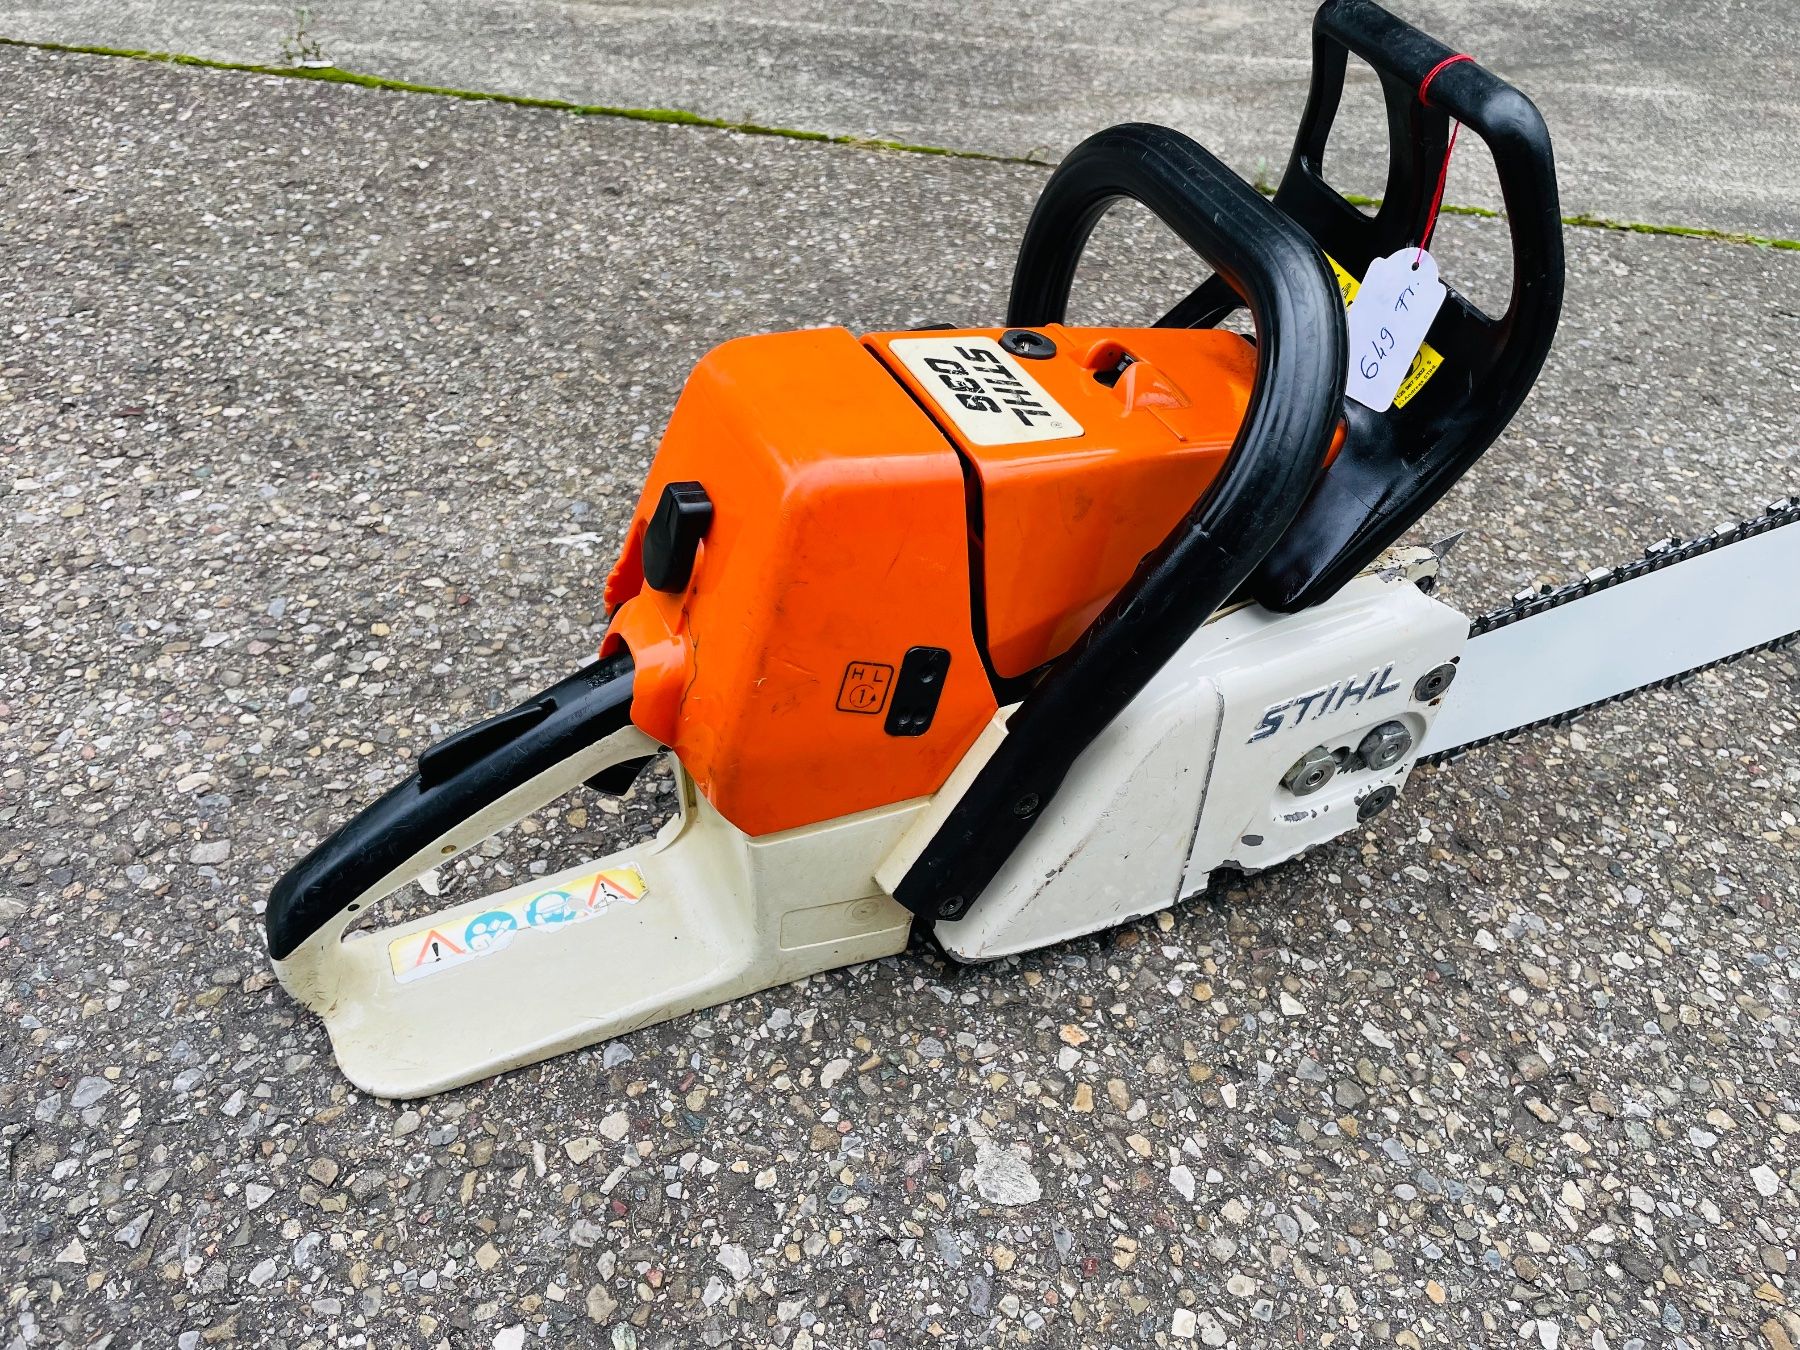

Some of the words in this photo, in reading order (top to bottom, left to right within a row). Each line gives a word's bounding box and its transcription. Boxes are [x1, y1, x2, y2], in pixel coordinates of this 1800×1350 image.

[1360, 327, 1395, 379] 649
[923, 357, 1002, 413] 036
[953, 345, 1052, 427] STIHL
[852, 667, 865, 680] H
[873, 670, 883, 682] L
[1246, 660, 1401, 743] STIHL
